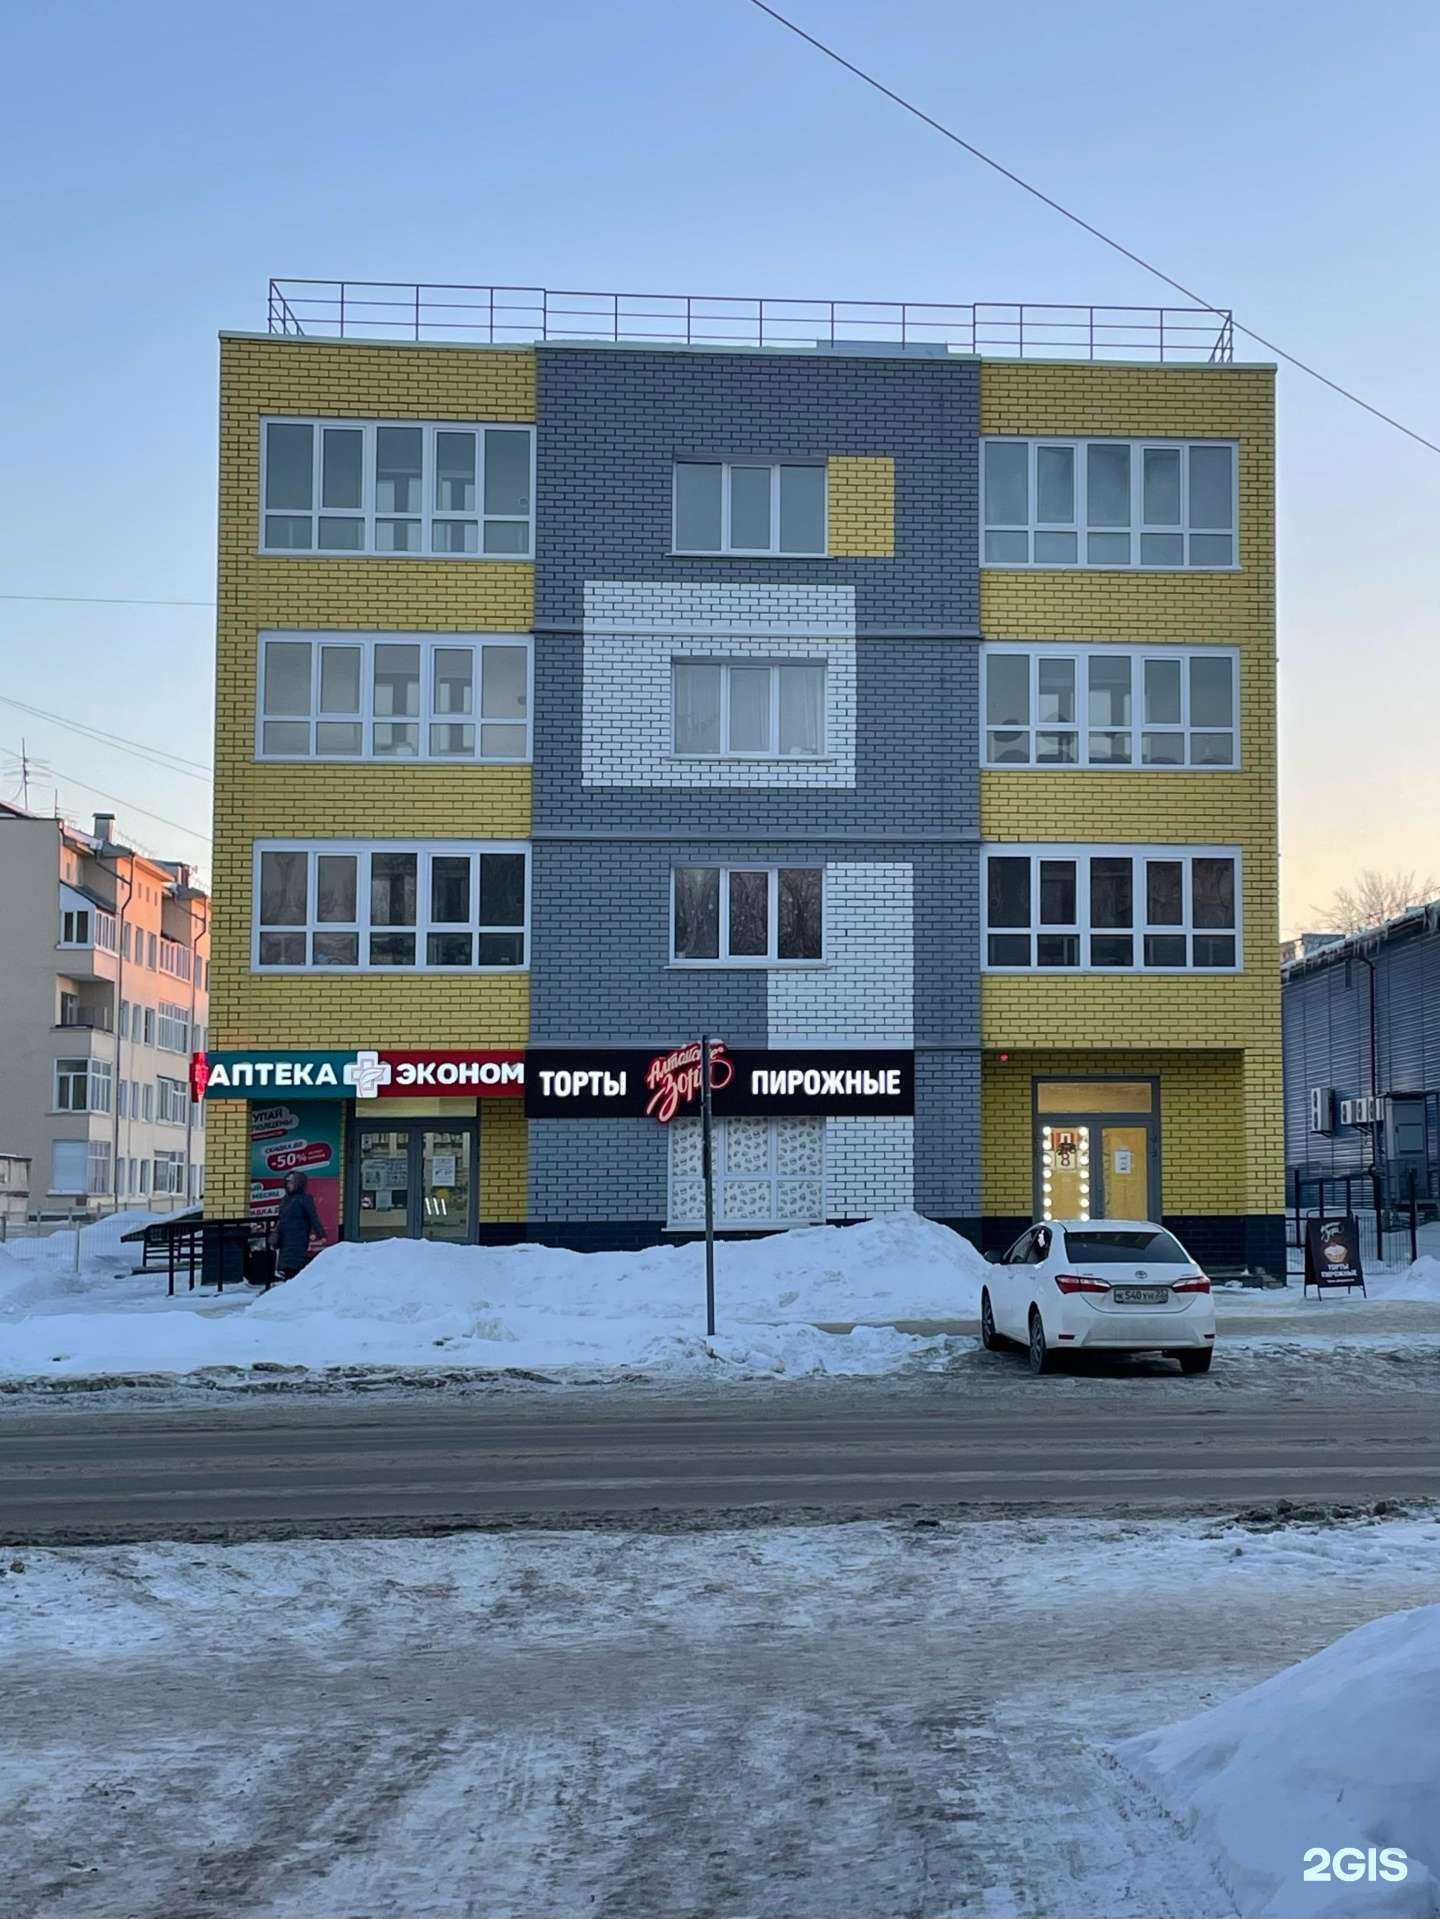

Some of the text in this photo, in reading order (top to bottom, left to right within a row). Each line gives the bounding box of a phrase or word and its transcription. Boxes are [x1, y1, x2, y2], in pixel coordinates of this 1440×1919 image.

[208, 1062, 525, 1086] АПТЕКА ЭКОНОМ
[540, 1071, 627, 1097] ТОРТЫ
[752, 1069, 901, 1095] ПИРОЖНЫЕ
[271, 1151, 307, 1168] -50%
